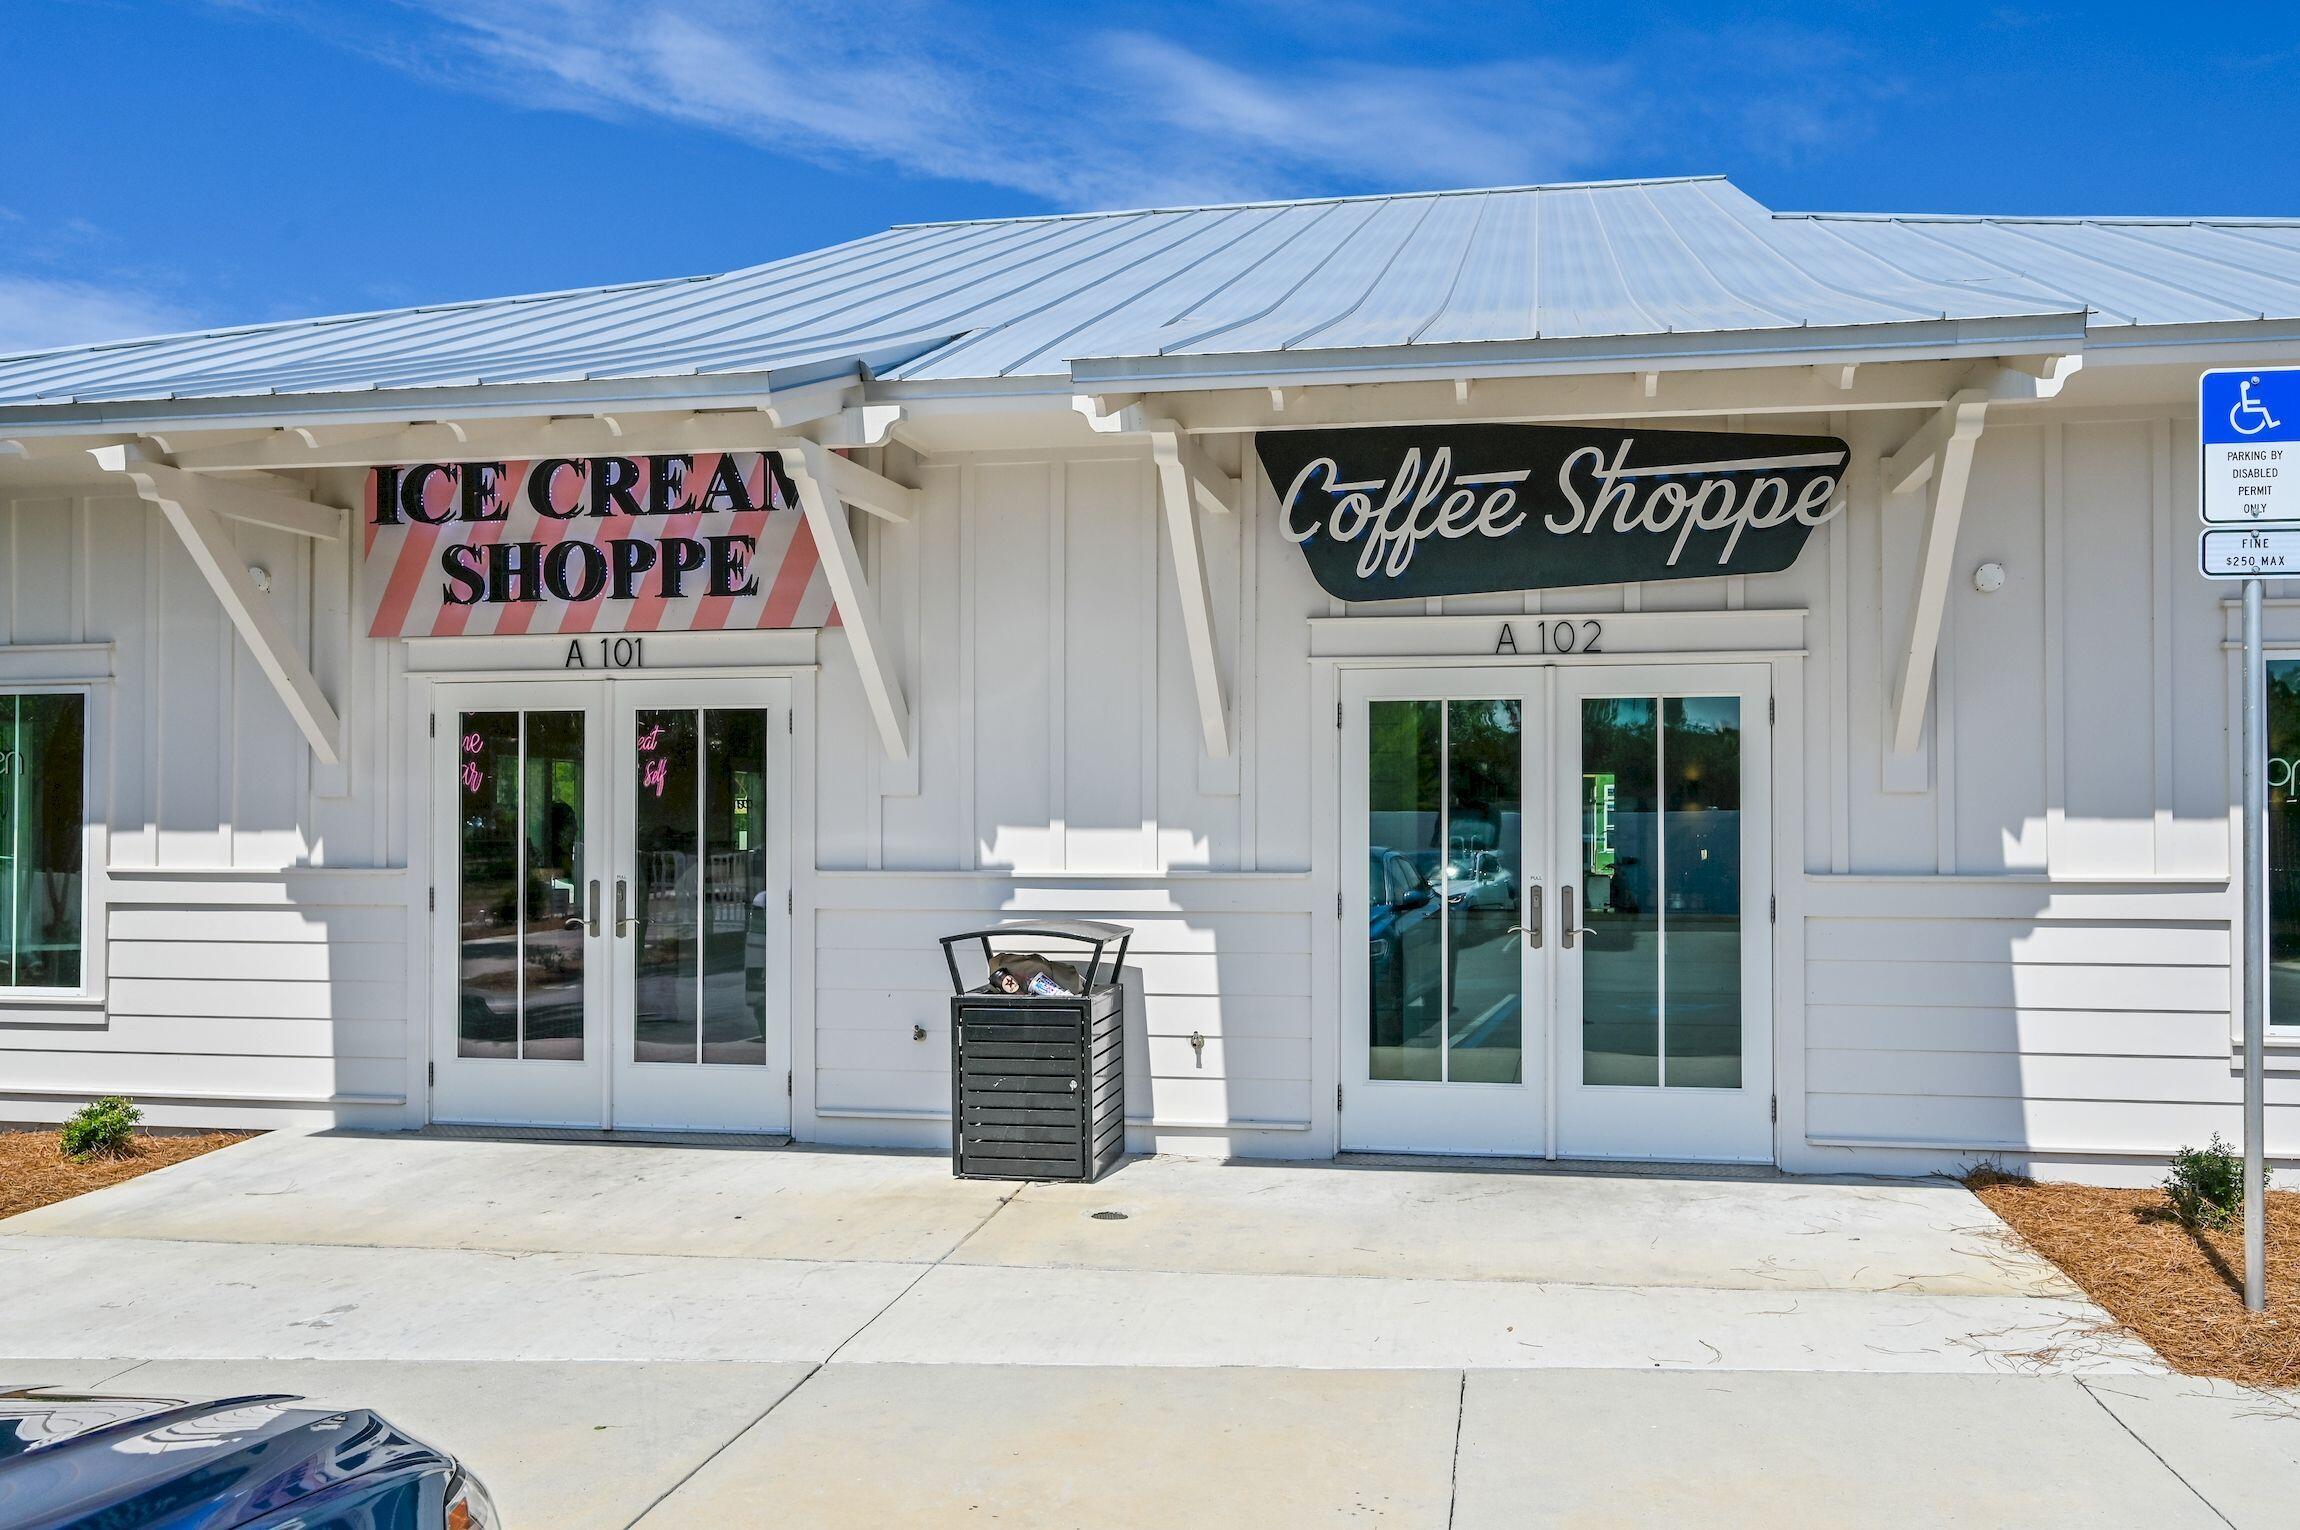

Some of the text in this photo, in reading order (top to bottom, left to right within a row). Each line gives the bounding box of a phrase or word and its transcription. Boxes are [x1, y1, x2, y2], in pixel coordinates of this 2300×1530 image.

[2227, 450, 2283, 461] PARKING BY
[2232, 468, 2278, 478] DISABLED
[370, 462, 510, 525] ICE
[2238, 486, 2272, 495] PERMIT
[1279, 438, 1847, 579] Coffee Shoppe
[2243, 503, 2266, 514] ONLY
[2242, 539, 2269, 549] FINE
[2226, 556, 2285, 566] $250 MAX
[442, 535, 760, 605] SHOPPE
[1495, 621, 1603, 654] A 102
[565, 638, 644, 668] A 101
